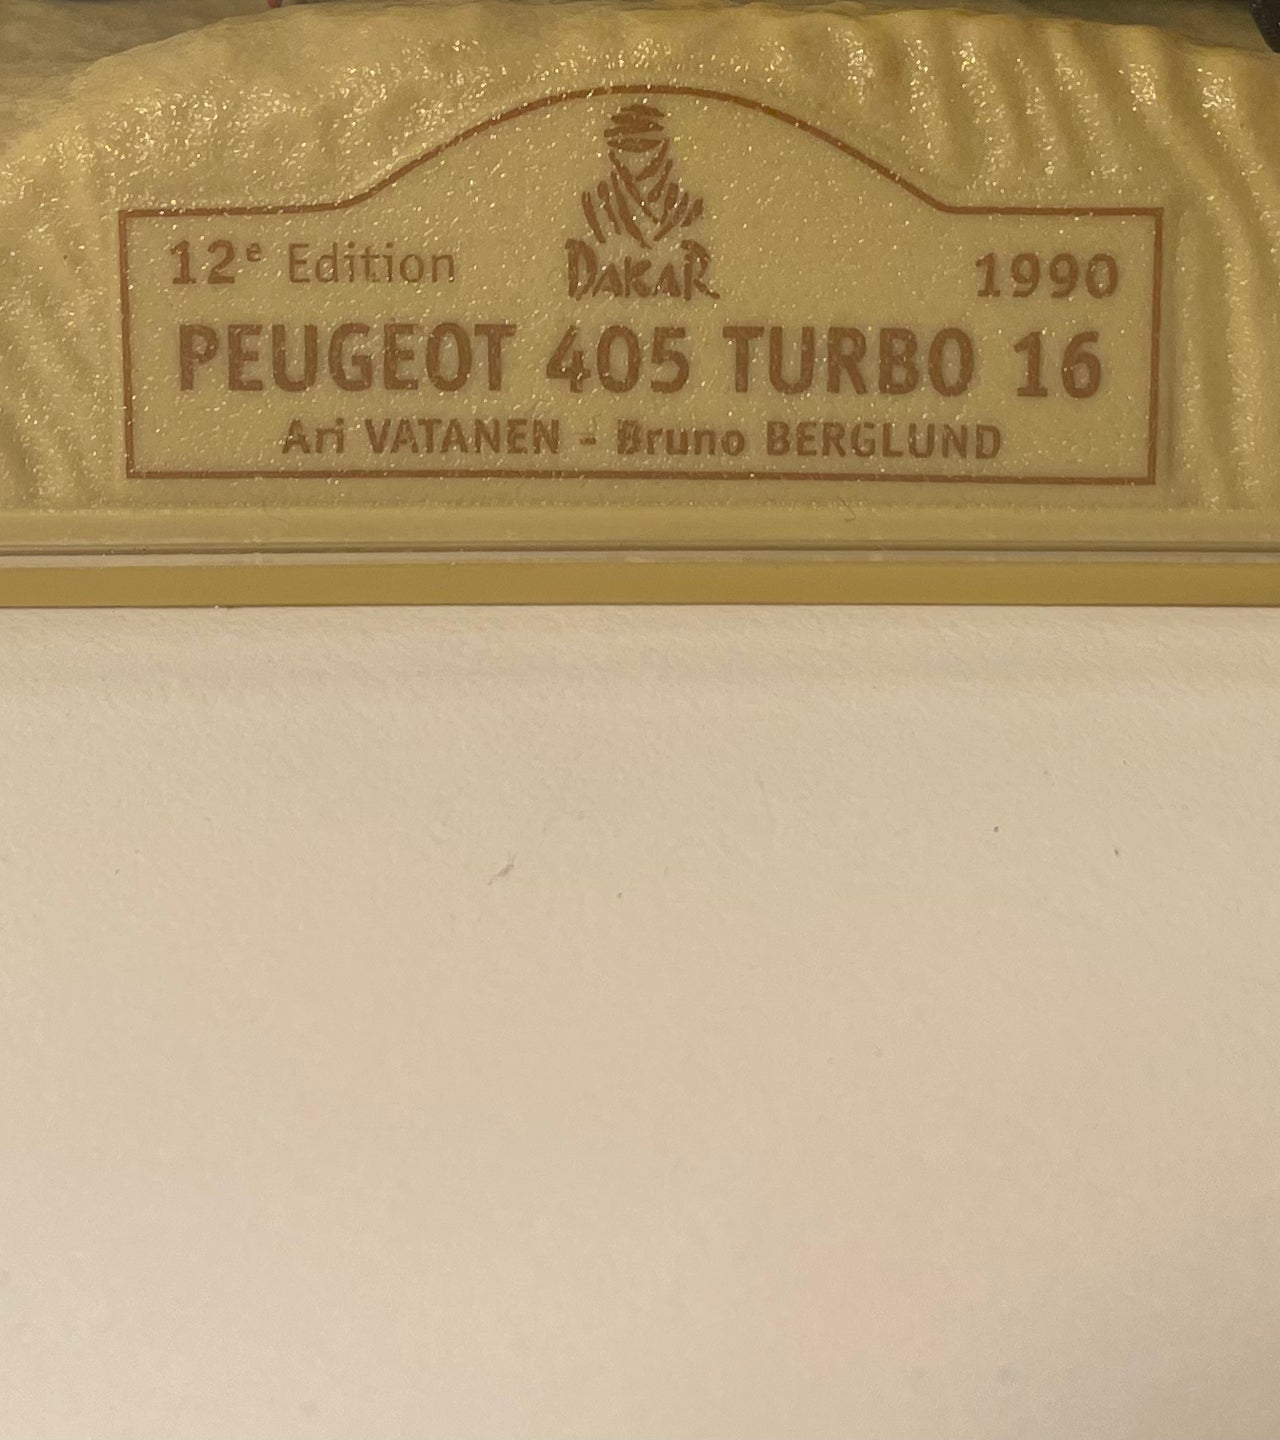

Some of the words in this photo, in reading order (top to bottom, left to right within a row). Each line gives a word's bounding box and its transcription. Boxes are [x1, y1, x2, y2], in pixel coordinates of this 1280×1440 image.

[288, 242, 456, 284] Edition
[975, 252, 1119, 299] 1990
[178, 322, 517, 393] PEUGEOT
[546, 325, 690, 394] 405
[722, 326, 975, 396] TURBO
[1012, 331, 1102, 399] 16
[281, 418, 345, 455] Ari
[365, 419, 561, 454] VATANEN
[616, 419, 746, 456] Bruno
[766, 420, 1003, 460] BERGLUND
